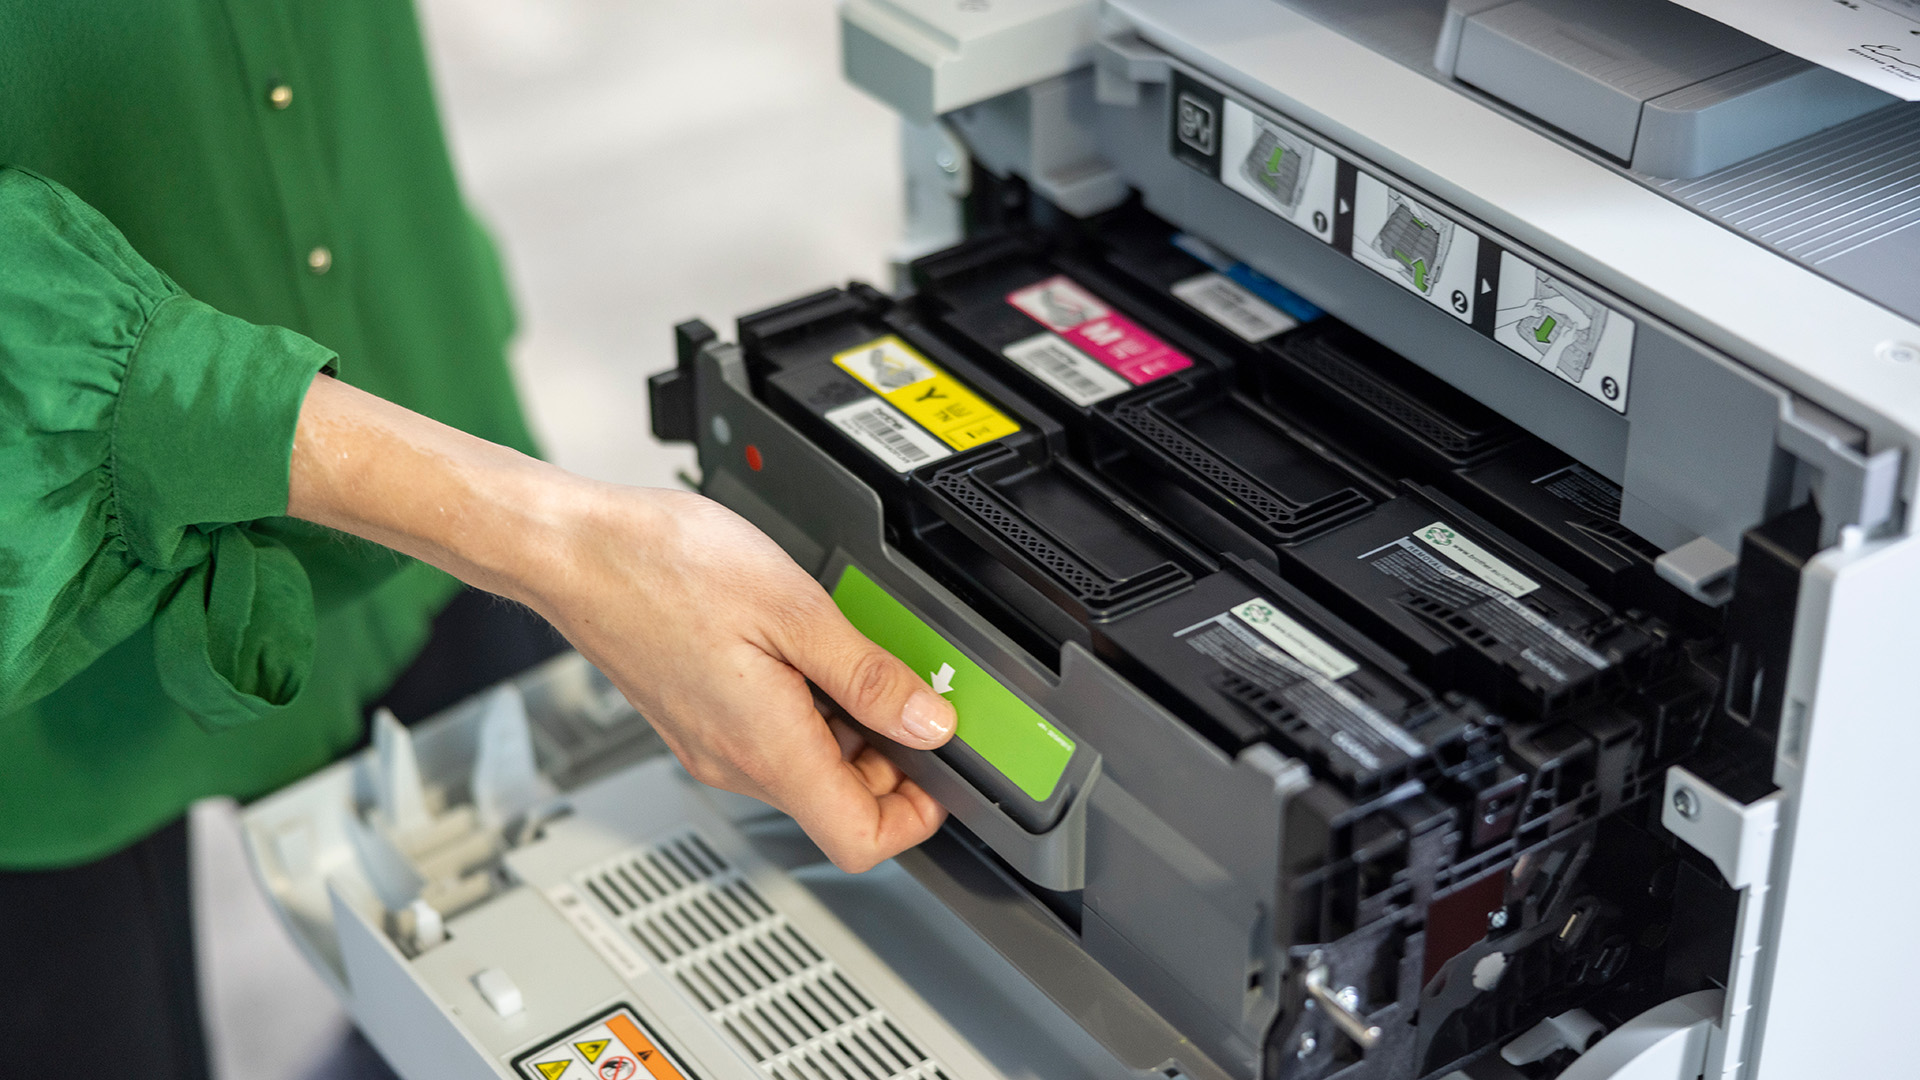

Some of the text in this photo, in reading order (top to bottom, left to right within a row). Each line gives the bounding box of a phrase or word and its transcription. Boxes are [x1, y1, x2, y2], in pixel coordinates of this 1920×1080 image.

[1454, 291, 1466, 312] 2
[1081, 321, 1123, 347] M
[915, 386, 949, 402] Y
[1603, 378, 1617, 399] 3
[1406, 545, 1443, 571] REMOVAL
